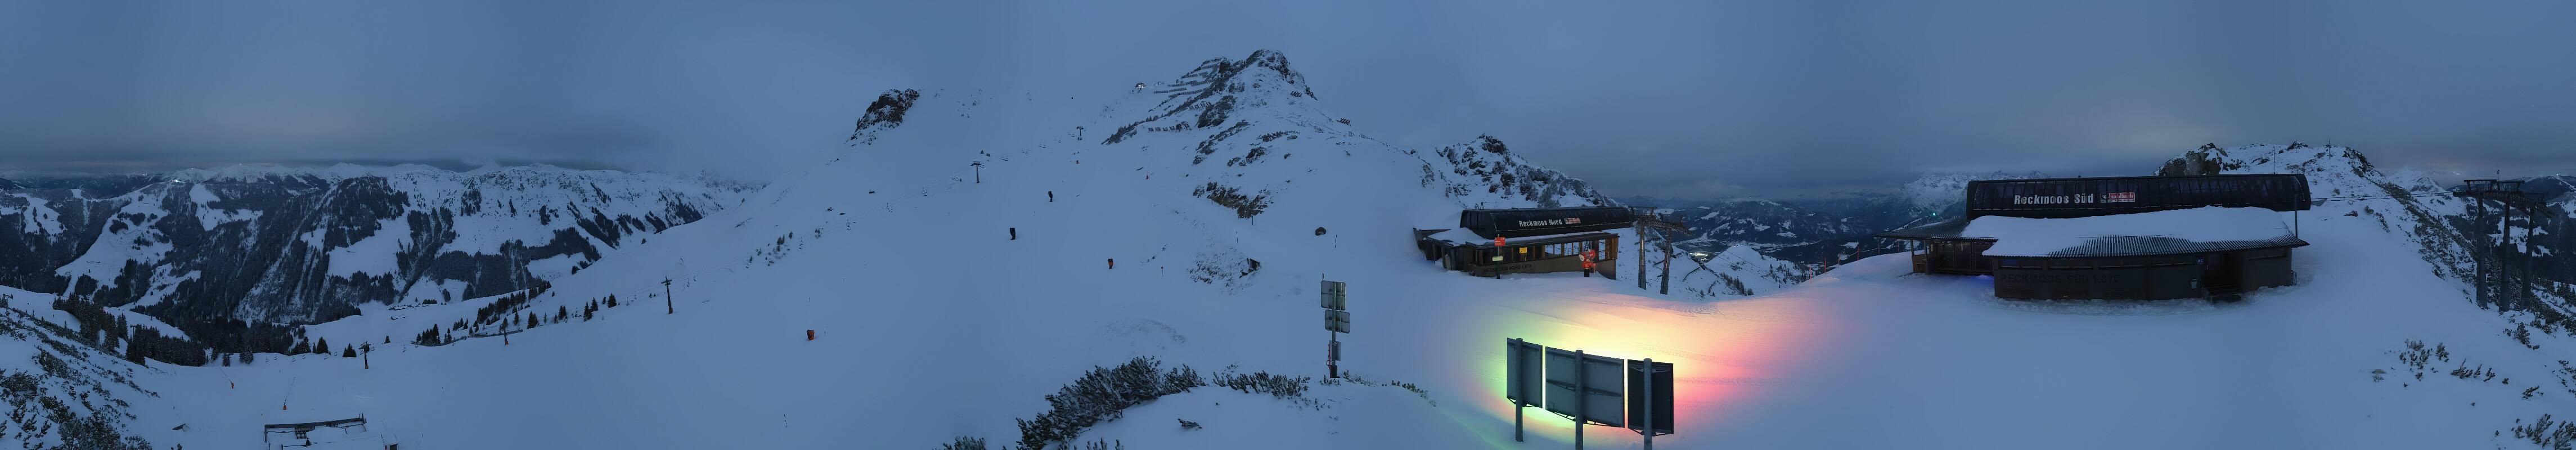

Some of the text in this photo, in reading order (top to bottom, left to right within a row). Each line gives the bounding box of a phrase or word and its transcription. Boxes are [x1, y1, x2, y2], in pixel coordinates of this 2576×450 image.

[2014, 193, 2094, 204] Reckmoos Süd
[2000, 274, 2061, 284] RECKMOOS
[2066, 273, 2089, 284] SÜD
